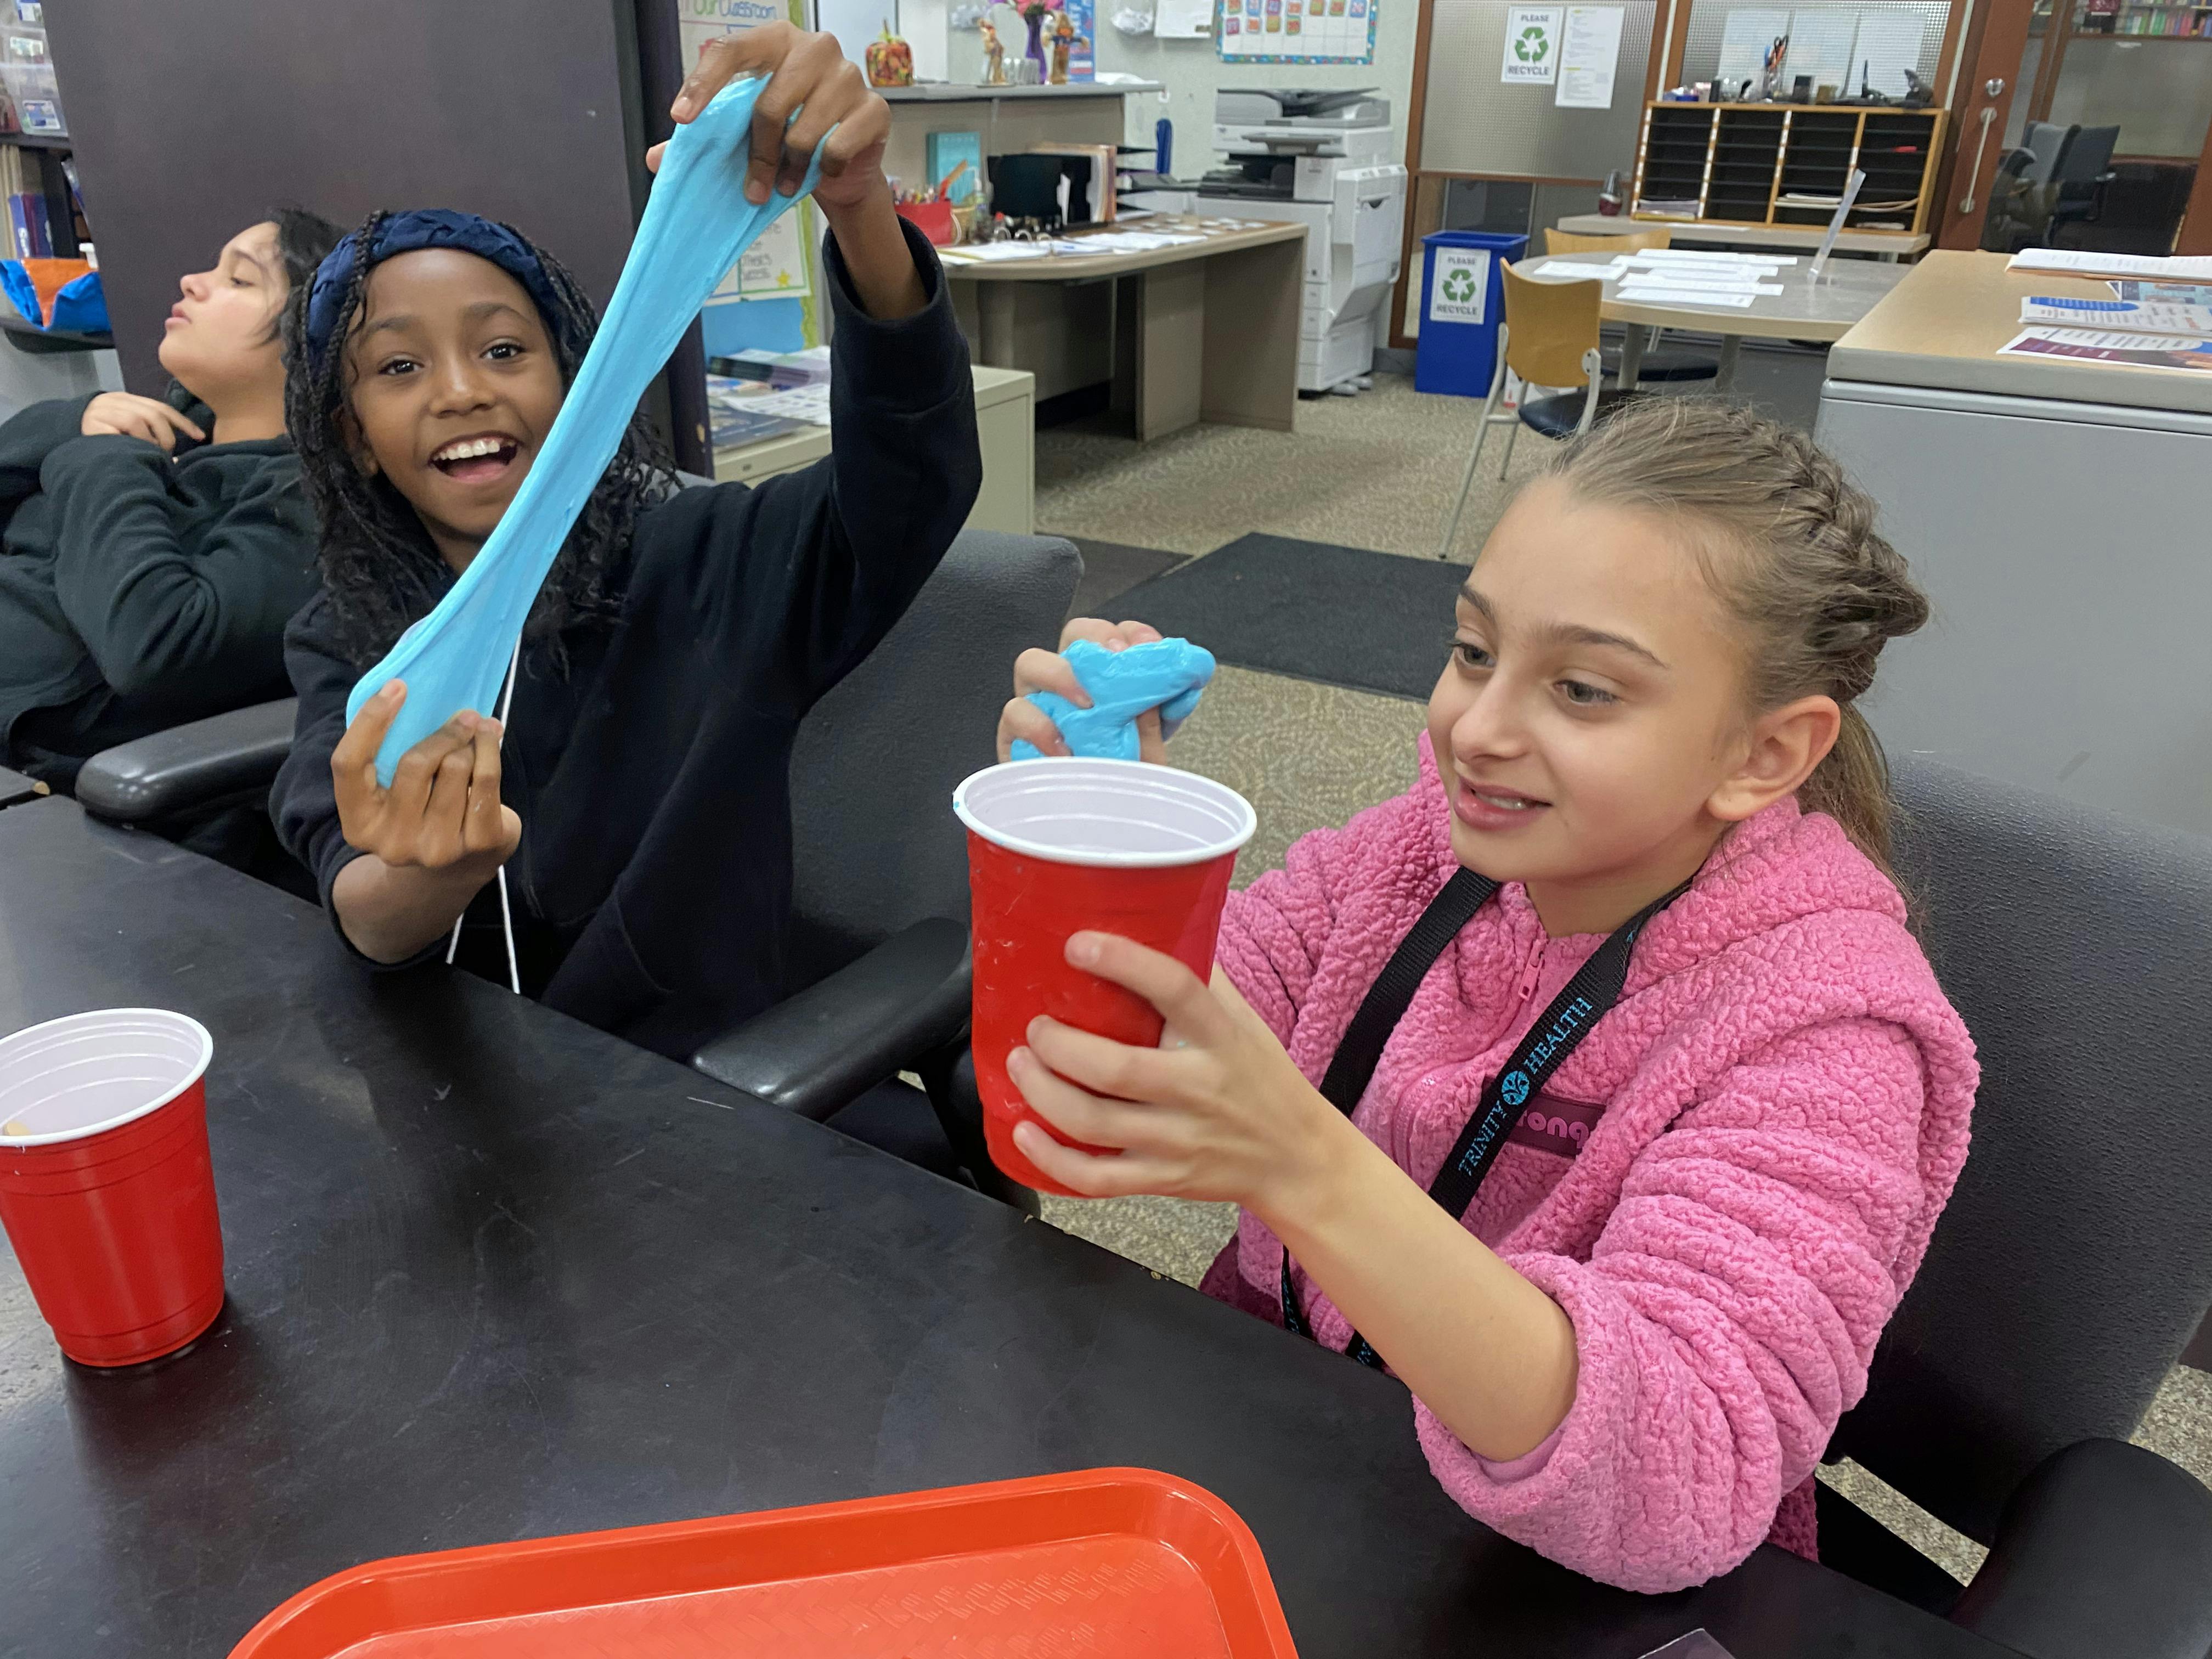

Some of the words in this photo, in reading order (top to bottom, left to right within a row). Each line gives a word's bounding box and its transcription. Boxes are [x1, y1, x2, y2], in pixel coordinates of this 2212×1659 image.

[1508, 65, 1550, 76] RECYCLE
[1448, 256, 1476, 264] PLEASE
[1437, 304, 1477, 315] RECYCLE
[1458, 1100, 1508, 1176] TRINITY
[1523, 997, 1593, 1074] HEALTH
